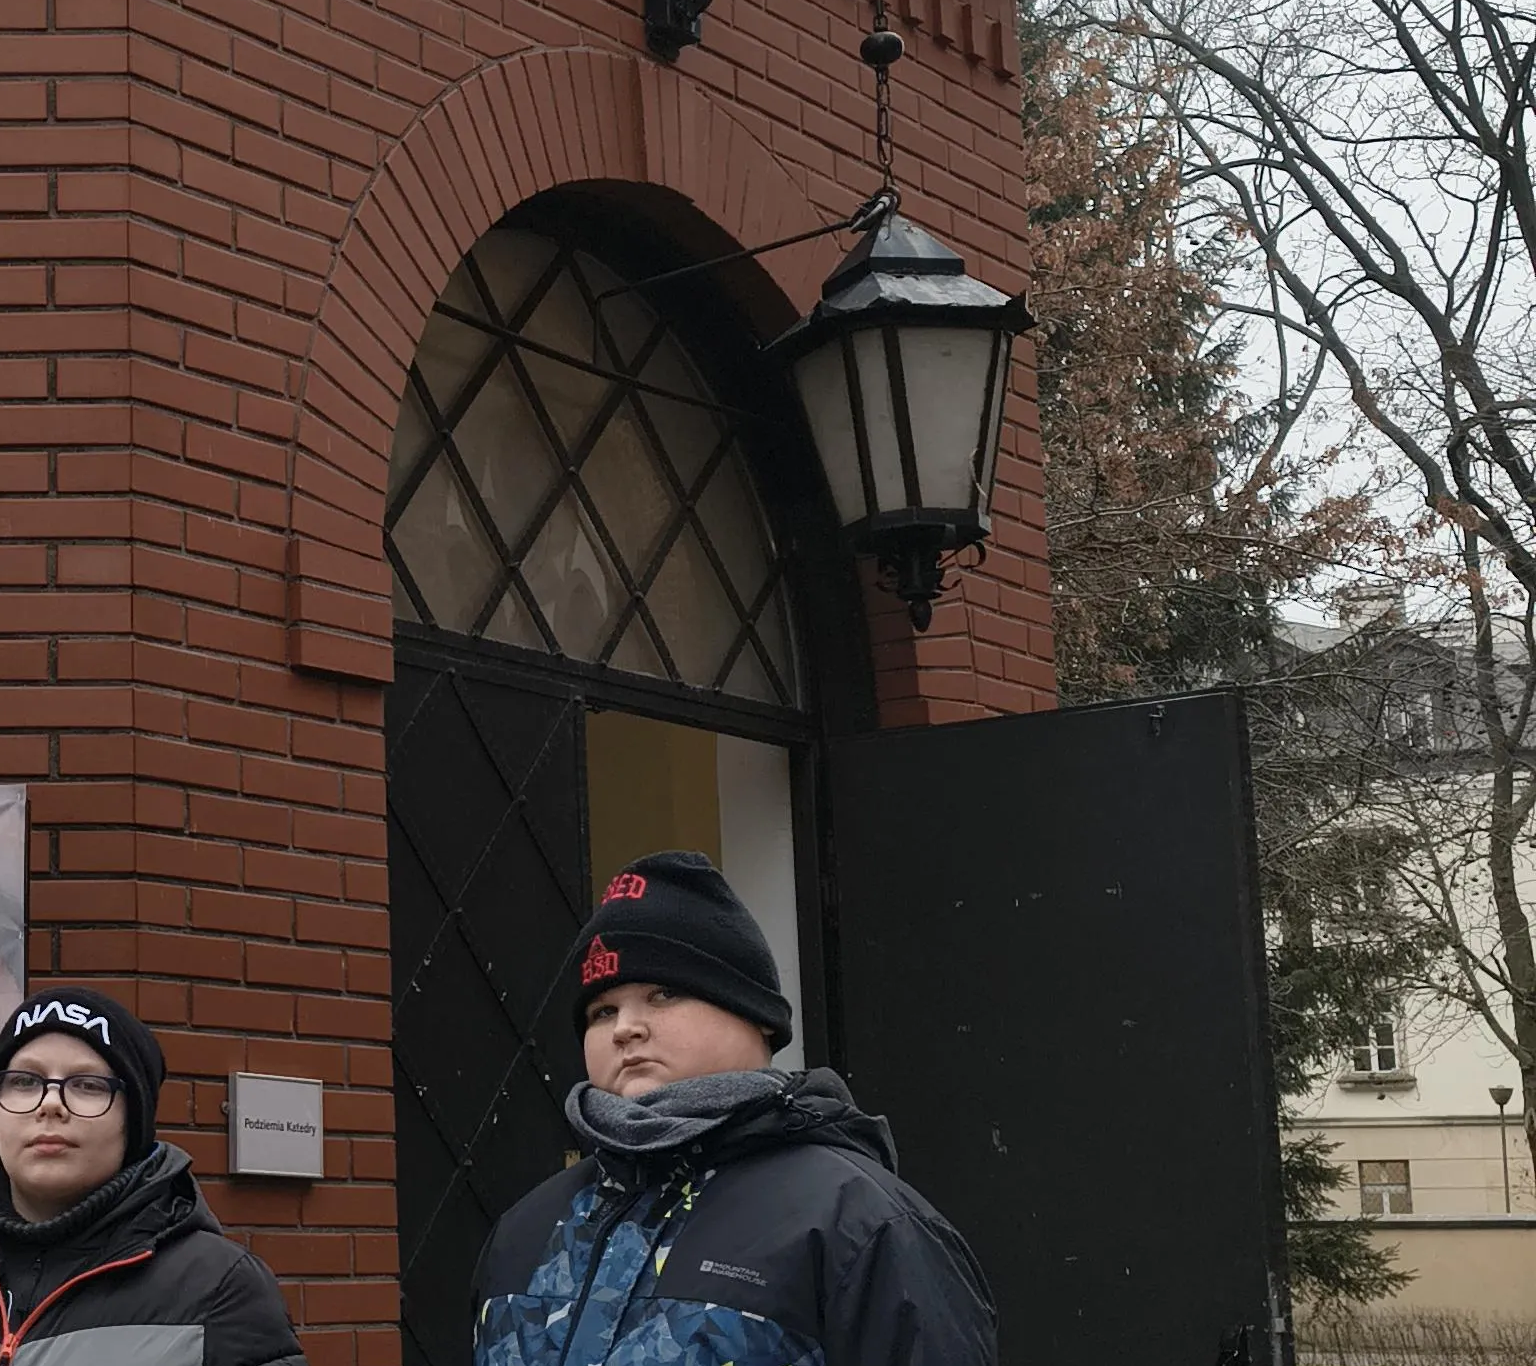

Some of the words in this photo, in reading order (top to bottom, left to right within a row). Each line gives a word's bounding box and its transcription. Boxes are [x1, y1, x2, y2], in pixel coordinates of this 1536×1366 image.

[14, 1000, 111, 1046] NASA
[244, 1117, 285, 1133] Podziemia
[286, 1120, 316, 1137] Katedry
